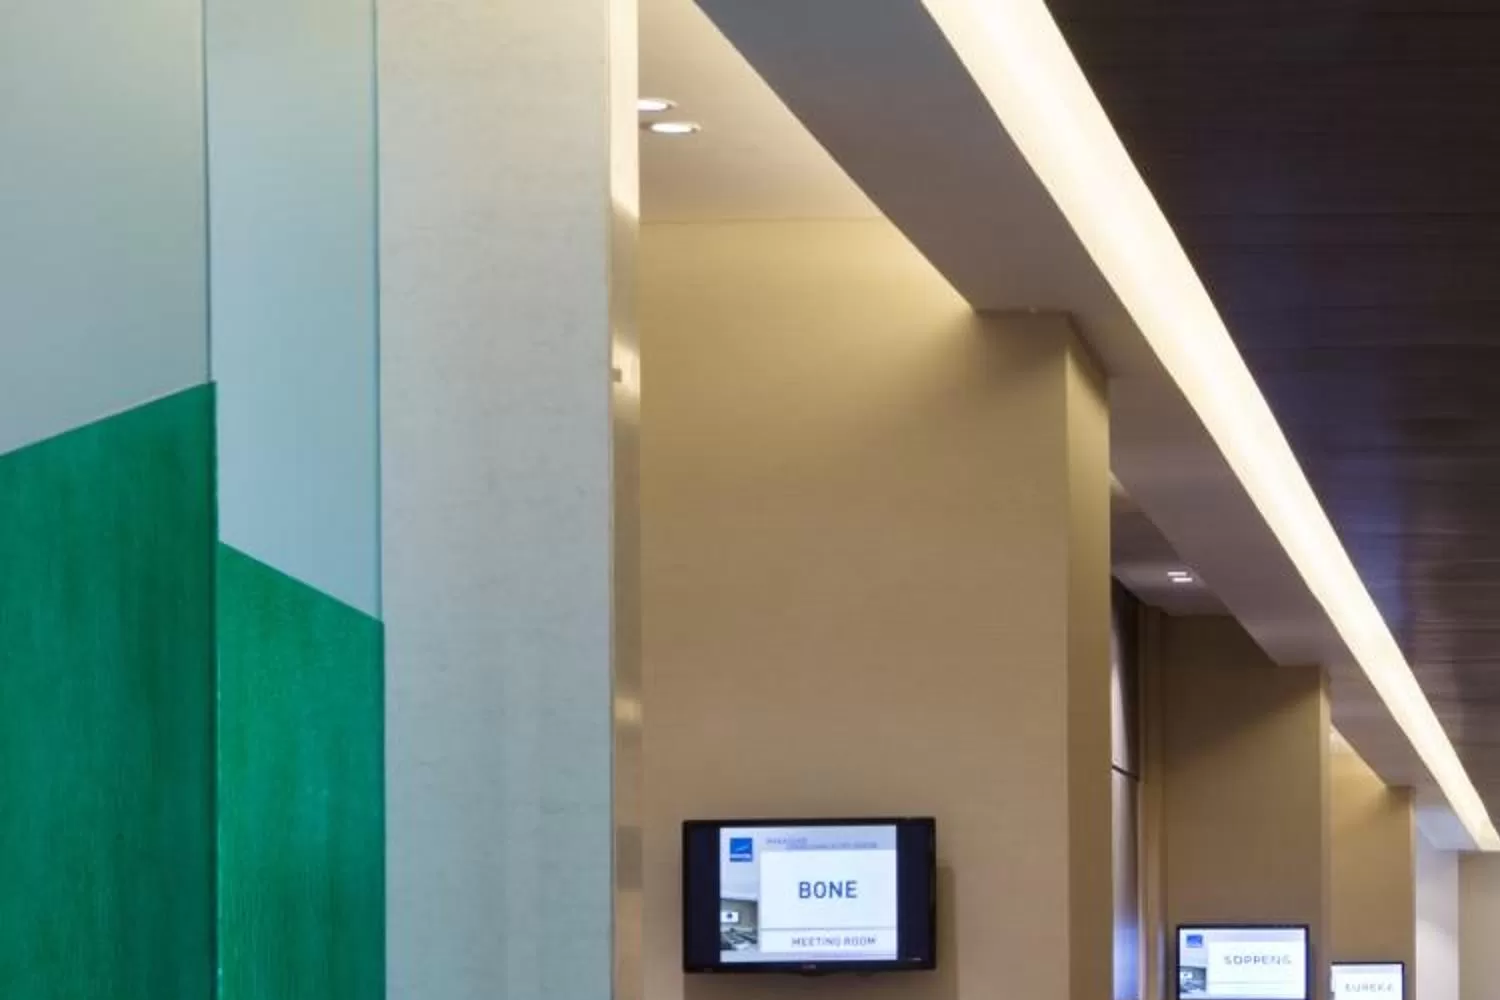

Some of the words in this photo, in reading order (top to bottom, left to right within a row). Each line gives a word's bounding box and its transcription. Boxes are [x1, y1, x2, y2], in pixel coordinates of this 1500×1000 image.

[799, 880, 858, 899] BONE
[791, 937, 841, 947] MEETING
[844, 936, 877, 946] ROOM
